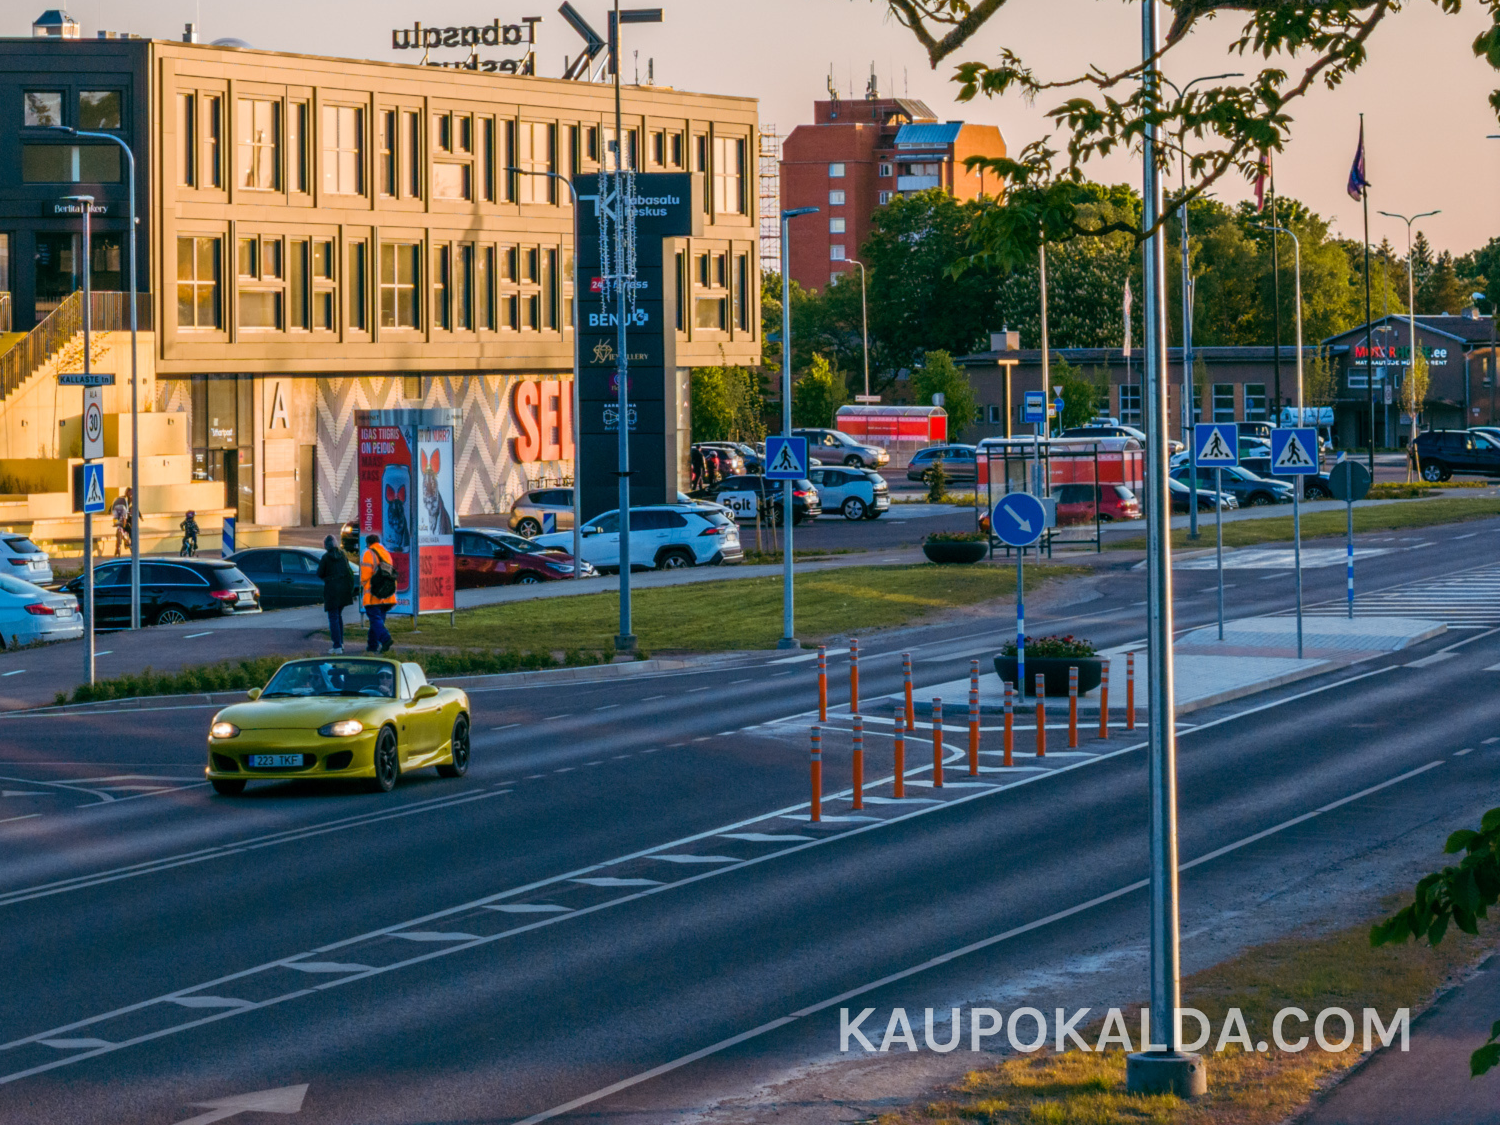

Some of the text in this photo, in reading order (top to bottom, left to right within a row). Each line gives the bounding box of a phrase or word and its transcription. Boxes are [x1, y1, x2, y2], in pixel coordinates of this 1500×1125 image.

[269, 381, 290, 429] A
[89, 413, 98, 432] 30
[361, 428, 377, 440] IGAS
[379, 428, 400, 440] TIIGRIS
[361, 441, 395, 454] ON PEIDUS
[723, 498, 751, 515] Bolt
[257, 755, 298, 766] 223 TKF
